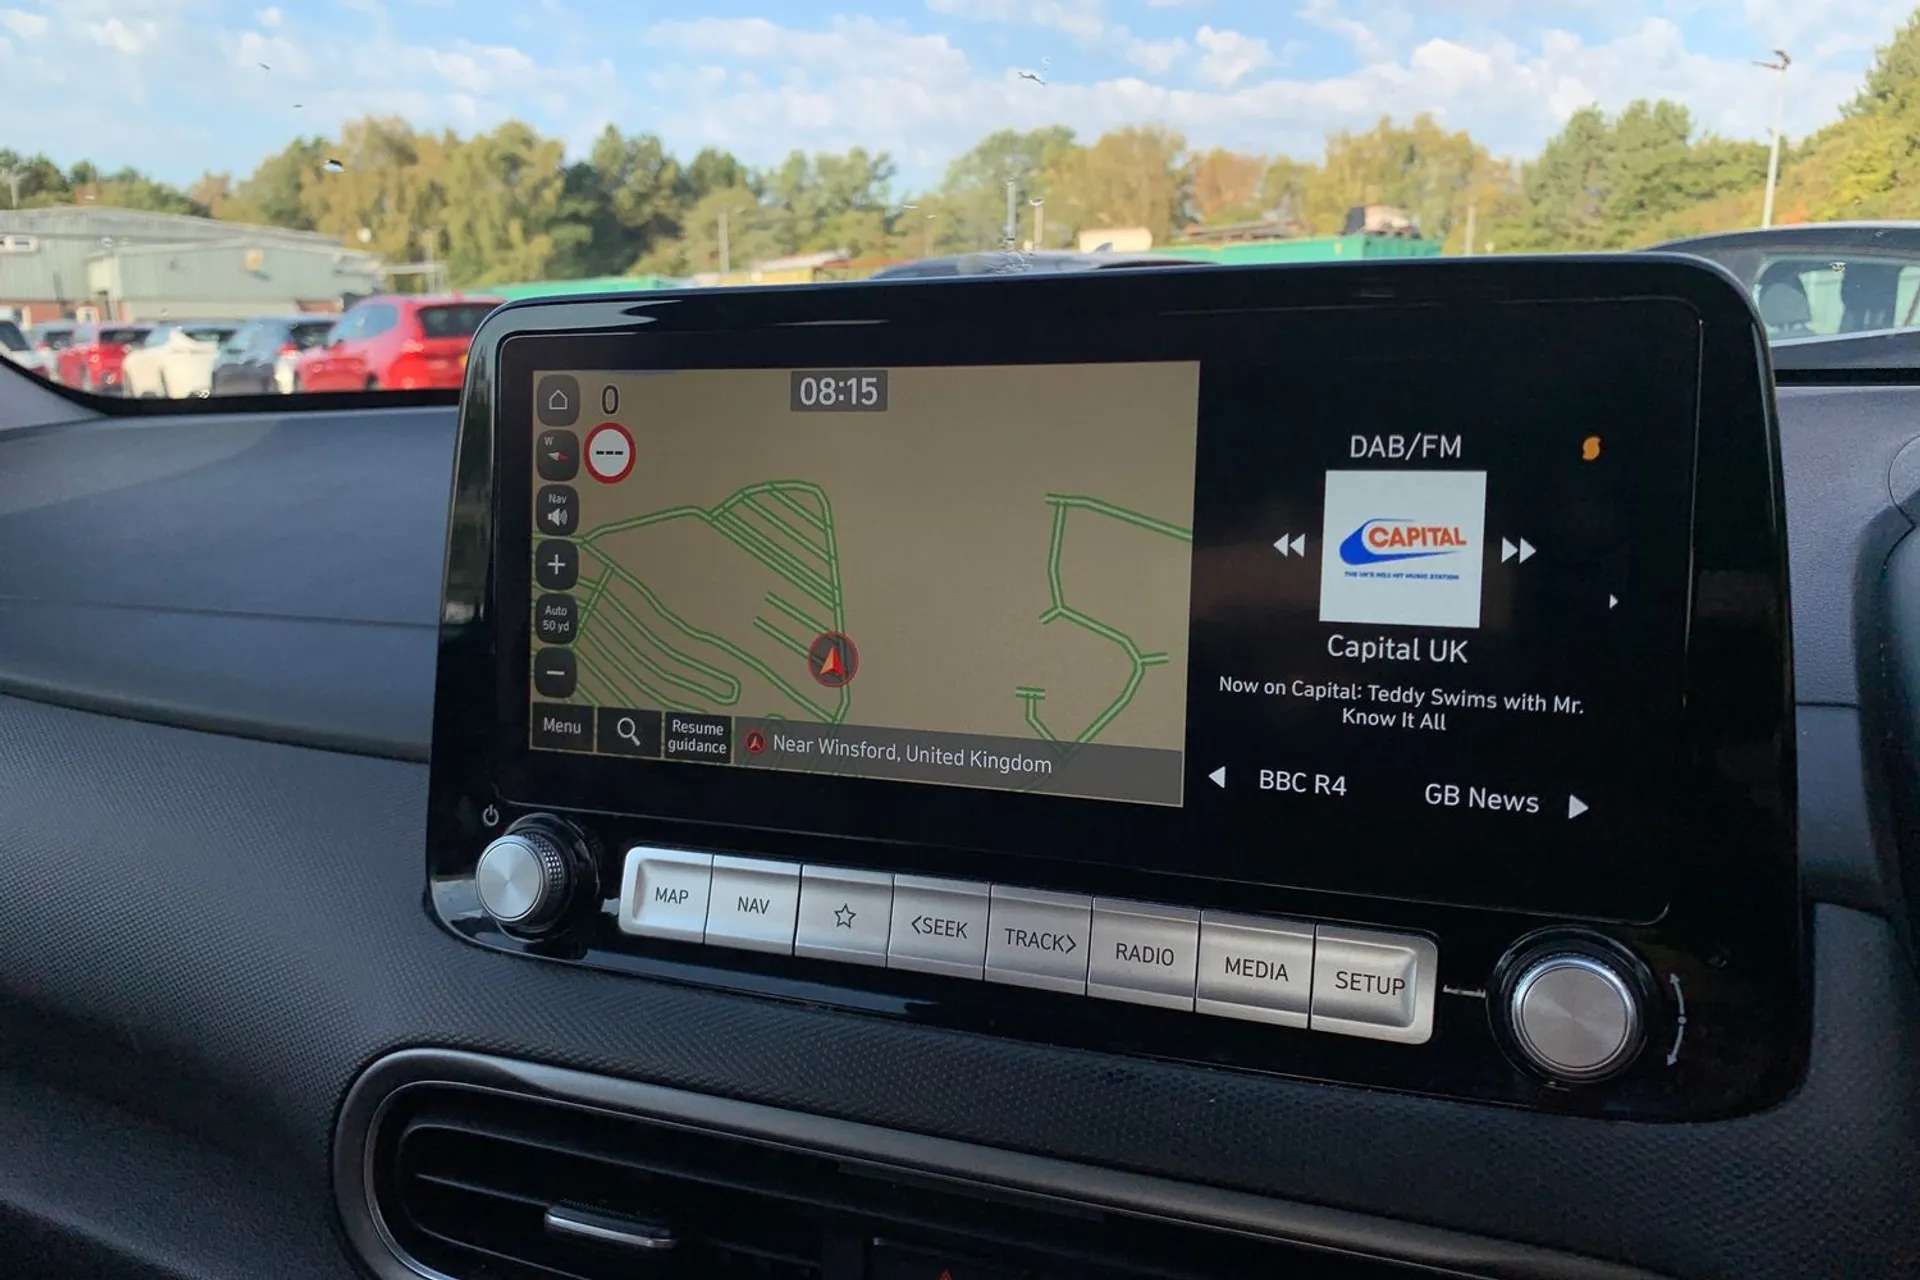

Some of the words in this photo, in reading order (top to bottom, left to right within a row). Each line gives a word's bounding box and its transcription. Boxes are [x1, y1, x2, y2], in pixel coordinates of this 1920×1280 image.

[602, 385, 619, 414] 0
[800, 377, 878, 405] 08:15
[544, 436, 554, 446] W
[1350, 433, 1462, 459] DAB/FM
[548, 494, 567, 505] Nav
[1368, 526, 1467, 548] CAPITAL
[544, 605, 568, 617] Auto
[543, 620, 556, 632] 50
[557, 621, 570, 633] yd
[1327, 634, 1420, 663] Capital
[1429, 638, 1468, 663] UK
[1219, 675, 1259, 694] Now
[1264, 682, 1286, 695] on
[1291, 680, 1362, 701] Capital:
[1368, 685, 1425, 708] Teddy
[1431, 688, 1497, 709] Swims
[1503, 693, 1547, 712] with
[1553, 695, 1584, 715] Mr.
[543, 717, 582, 734] Menu
[672, 719, 724, 736] Resume
[1342, 707, 1396, 727] Know
[1402, 711, 1415, 729] It
[1419, 712, 1447, 731] All
[667, 738, 727, 755] guidance
[773, 735, 814, 754] Near
[817, 737, 901, 763] Winsford,
[906, 745, 964, 767] United
[970, 750, 1052, 775] Kingdom
[1259, 769, 1307, 793] BBC
[1314, 774, 1347, 796] R4
[1425, 783, 1460, 807] GB
[1469, 786, 1539, 814] News
[655, 887, 689, 905] MAP
[738, 896, 770, 915] NAV
[1115, 942, 1175, 967] RADIO
[1224, 957, 1289, 982] MEDIA
[1335, 970, 1406, 997] SETUP
